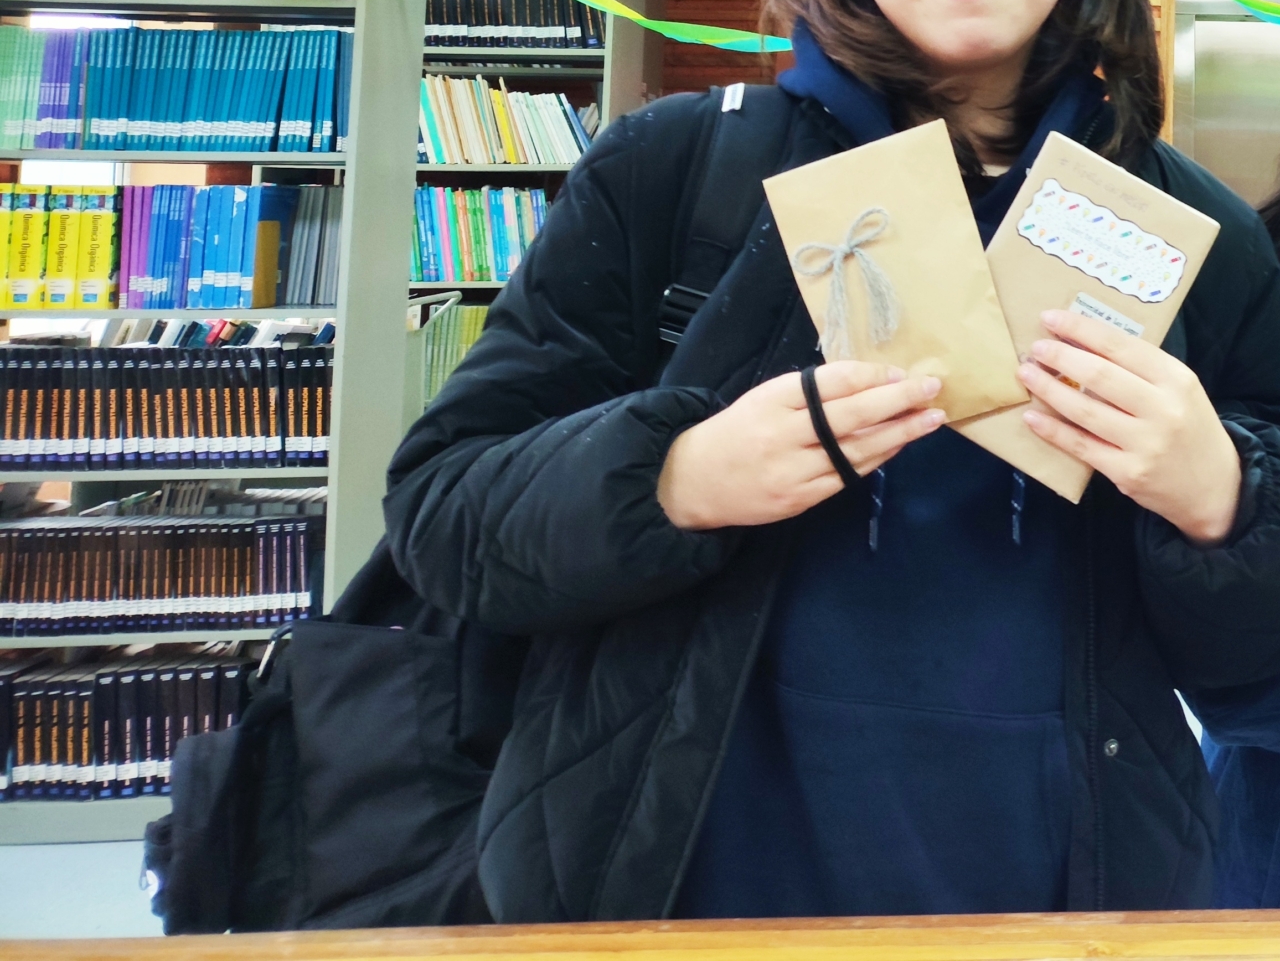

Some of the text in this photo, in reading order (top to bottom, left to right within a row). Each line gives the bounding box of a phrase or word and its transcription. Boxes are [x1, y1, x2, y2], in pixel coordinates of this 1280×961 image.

[18, 214, 33, 272] Química Orgánica
[54, 214, 70, 272] Química Orgánica
[87, 214, 102, 272] Química Orgánica
